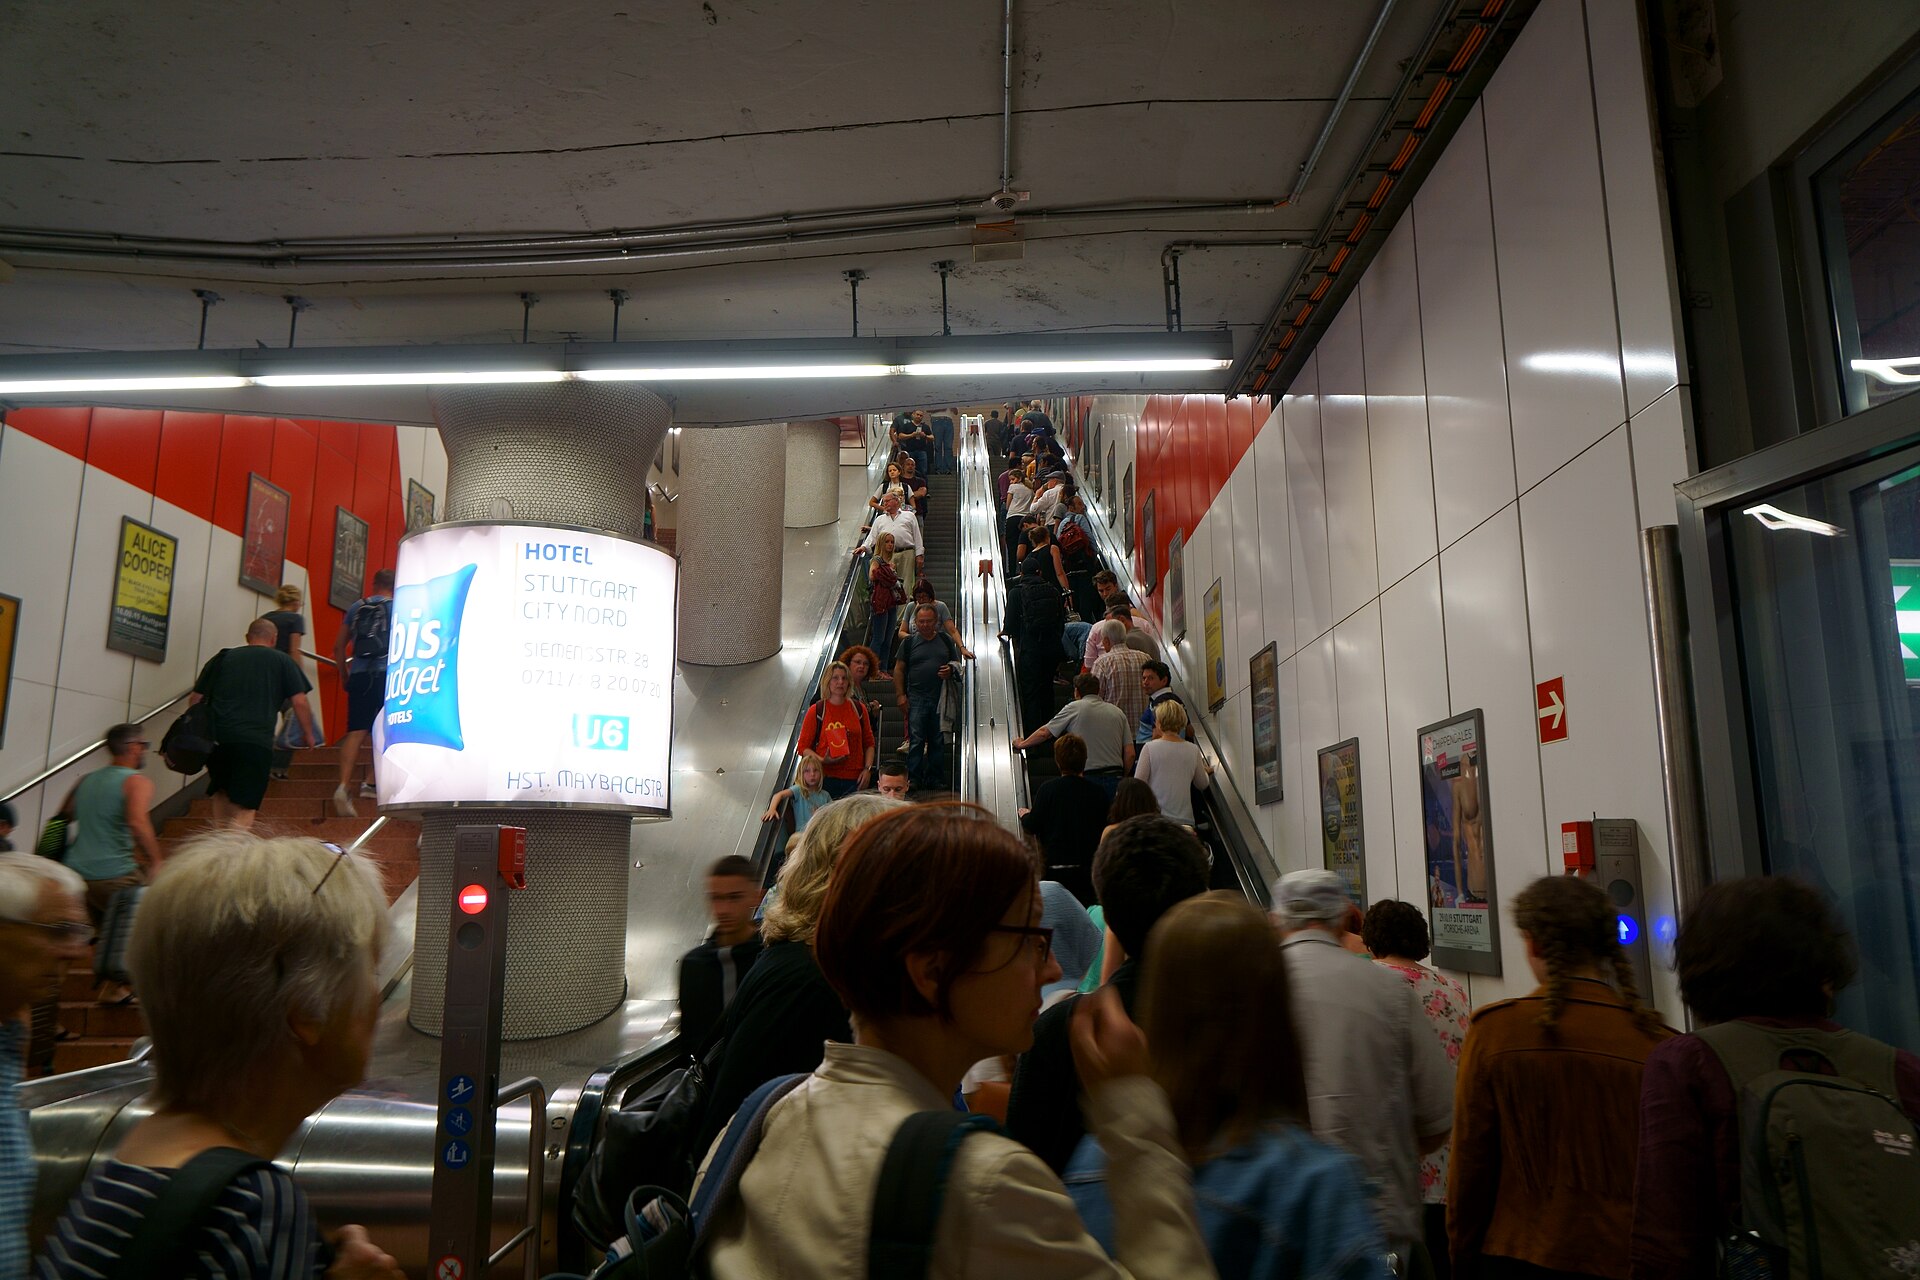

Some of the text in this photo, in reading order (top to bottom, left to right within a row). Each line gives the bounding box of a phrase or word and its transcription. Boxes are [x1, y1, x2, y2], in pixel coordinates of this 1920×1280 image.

[132, 532, 168, 561] ALICE
[525, 542, 594, 566] HOTEL
[123, 550, 172, 584] COOPER
[524, 574, 638, 603] STUTTGART
[387, 608, 441, 666] bis
[633, 652, 649, 669] 28
[607, 675, 628, 692] 20
[632, 678, 647, 695] 07
[649, 682, 661, 699] 20
[576, 718, 624, 747] U6
[1432, 728, 1472, 751] CHIPPENDALES
[507, 770, 664, 798] HST. MAYBACHSTR.
[1443, 923, 1480, 936] PORSCHE-ARENA
[1453, 913, 1482, 925] STUTTGART
